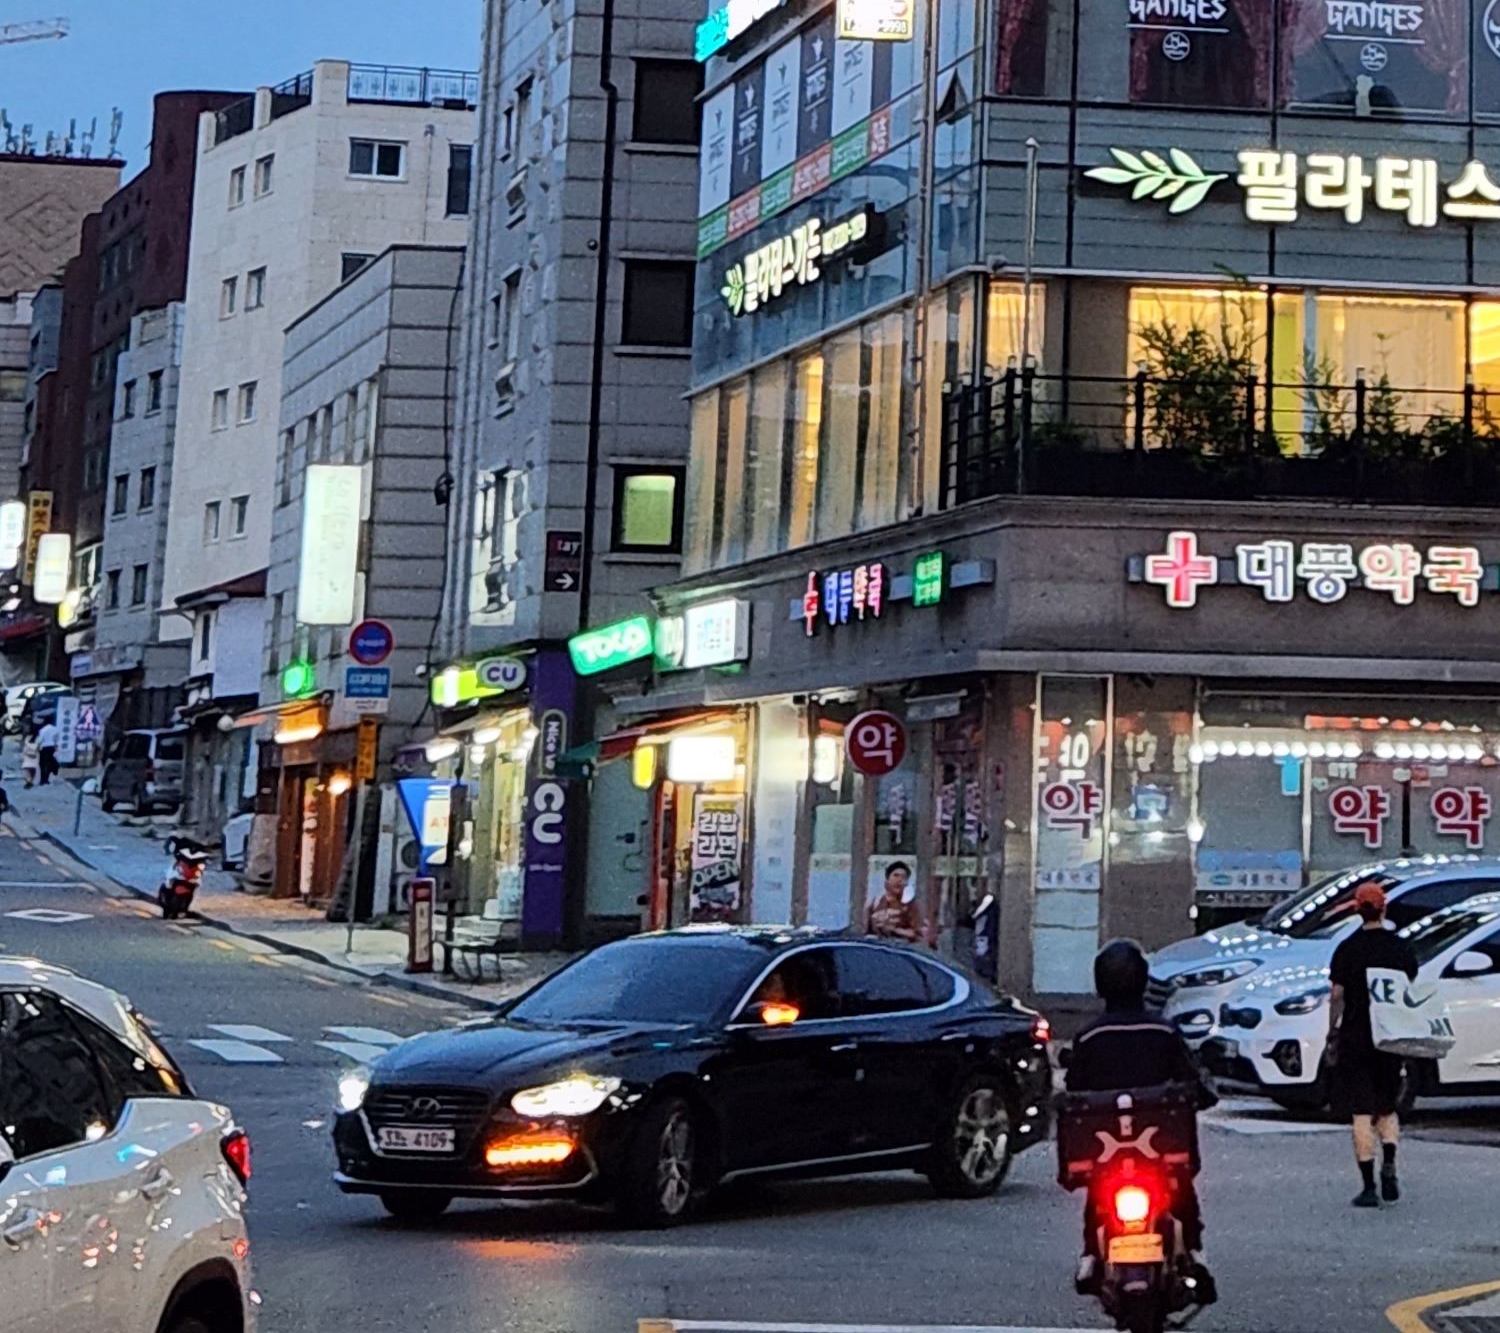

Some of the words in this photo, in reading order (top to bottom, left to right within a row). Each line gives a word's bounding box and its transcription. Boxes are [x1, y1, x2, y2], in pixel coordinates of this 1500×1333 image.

[1324, 0, 1425, 36] GANGES
[1236, 539, 1484, 607] 대풍약국
[486, 666, 518, 683] CU
[856, 721, 898, 767] 약
[532, 782, 566, 844] CU
[698, 812, 738, 834] 김밥
[1041, 780, 1103, 841] 약
[1328, 785, 1392, 849] 약
[1431, 786, 1492, 850] 약
[697, 834, 738, 858] 라면
